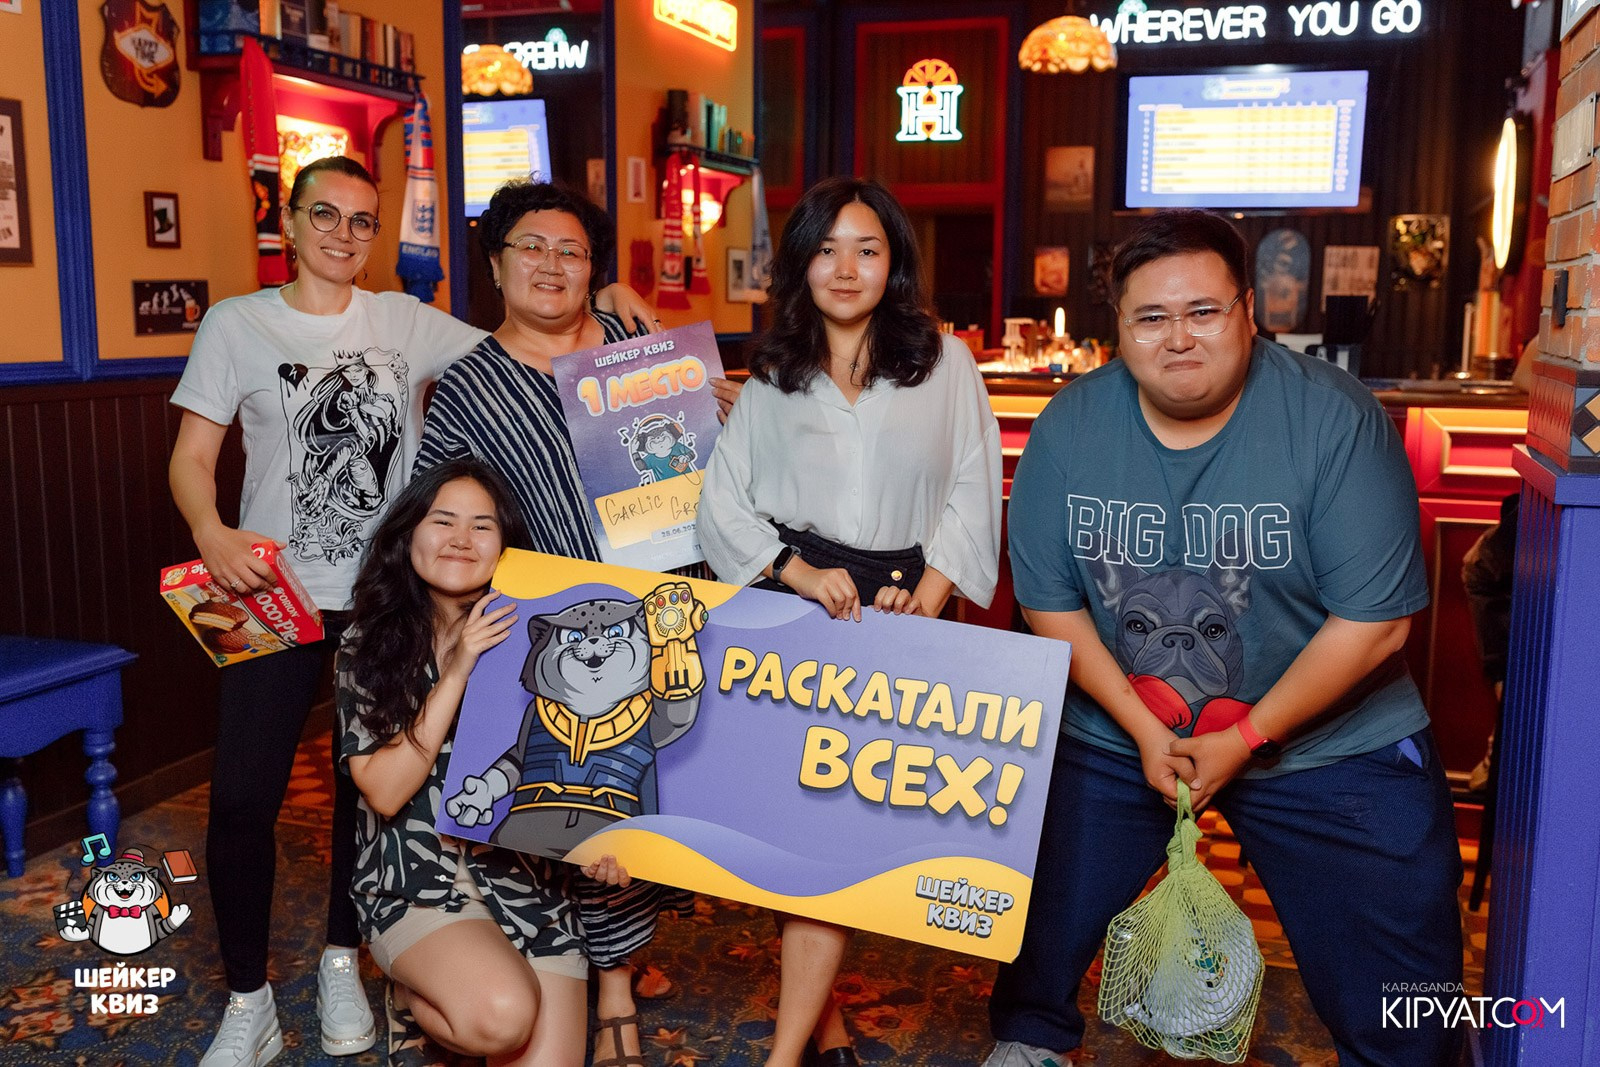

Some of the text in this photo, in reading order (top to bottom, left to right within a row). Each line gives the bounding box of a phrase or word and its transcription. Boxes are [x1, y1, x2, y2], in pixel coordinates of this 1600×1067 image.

[1089, 0, 1422, 44] WHEREVER YOU GO
[594, 340, 675, 369] ШЕЙКЕР КВИЗ
[577, 355, 707, 416] 1 МЕСТО
[1067, 494, 1293, 570] BIG DOG
[278, 592, 300, 618] ORION
[718, 646, 1044, 749] РАСКАТАЛИ
[798, 725, 1026, 827] ВСЕХ!
[916, 875, 1014, 915] ШЕЙКЕР
[926, 903, 993, 938] КВИЗ
